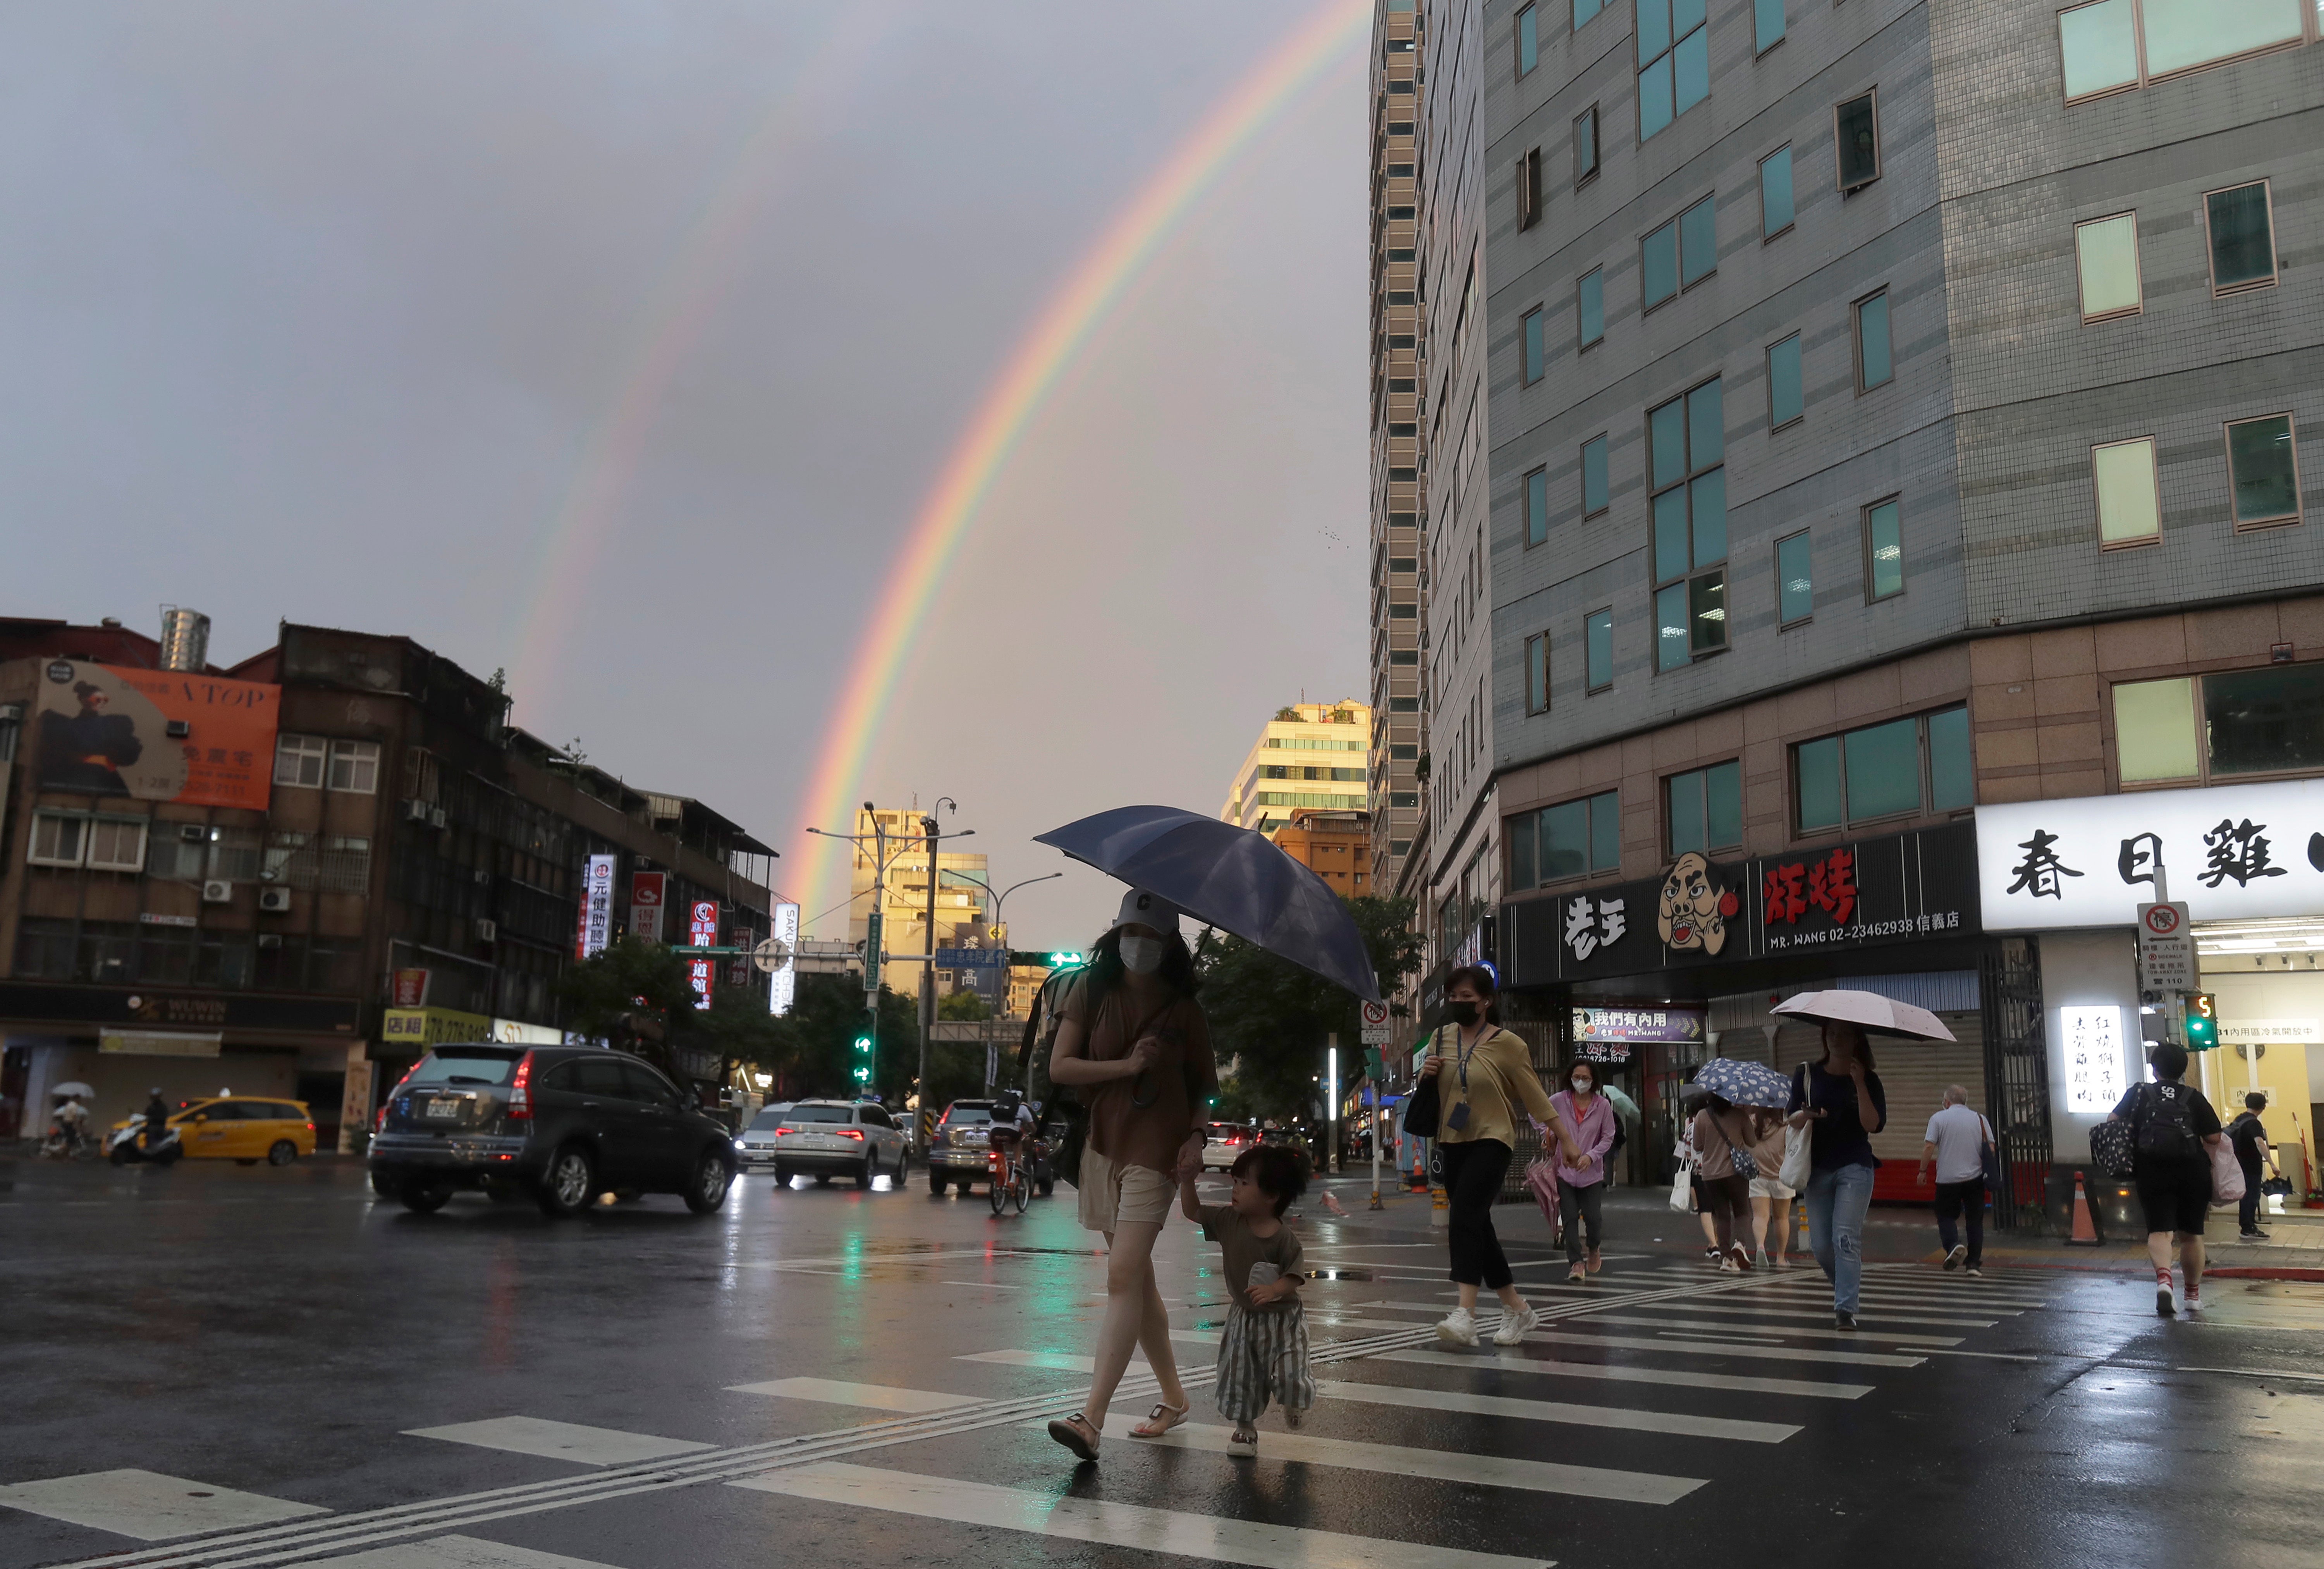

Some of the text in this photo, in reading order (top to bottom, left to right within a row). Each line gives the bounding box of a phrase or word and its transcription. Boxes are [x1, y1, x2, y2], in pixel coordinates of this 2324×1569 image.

[2007, 818, 2324, 900] 春日雞
[1137, 894, 1151, 910] C
[1764, 848, 1857, 924] 炸烤
[785, 910, 794, 955] SAKUR
[1565, 896, 1626, 961] 老王
[1794, 931, 1826, 944] WANG
[1830, 920, 1913, 940] 02-23462938
[1917, 911, 1959, 932] 信義店
[2154, 911, 2172, 927] 停
[692, 933, 710, 993] 跆道館
[956, 950, 995, 963] 忠孝院區
[1595, 1011, 1667, 1027] 我們有內用
[2161, 1086, 2175, 1101] SP
